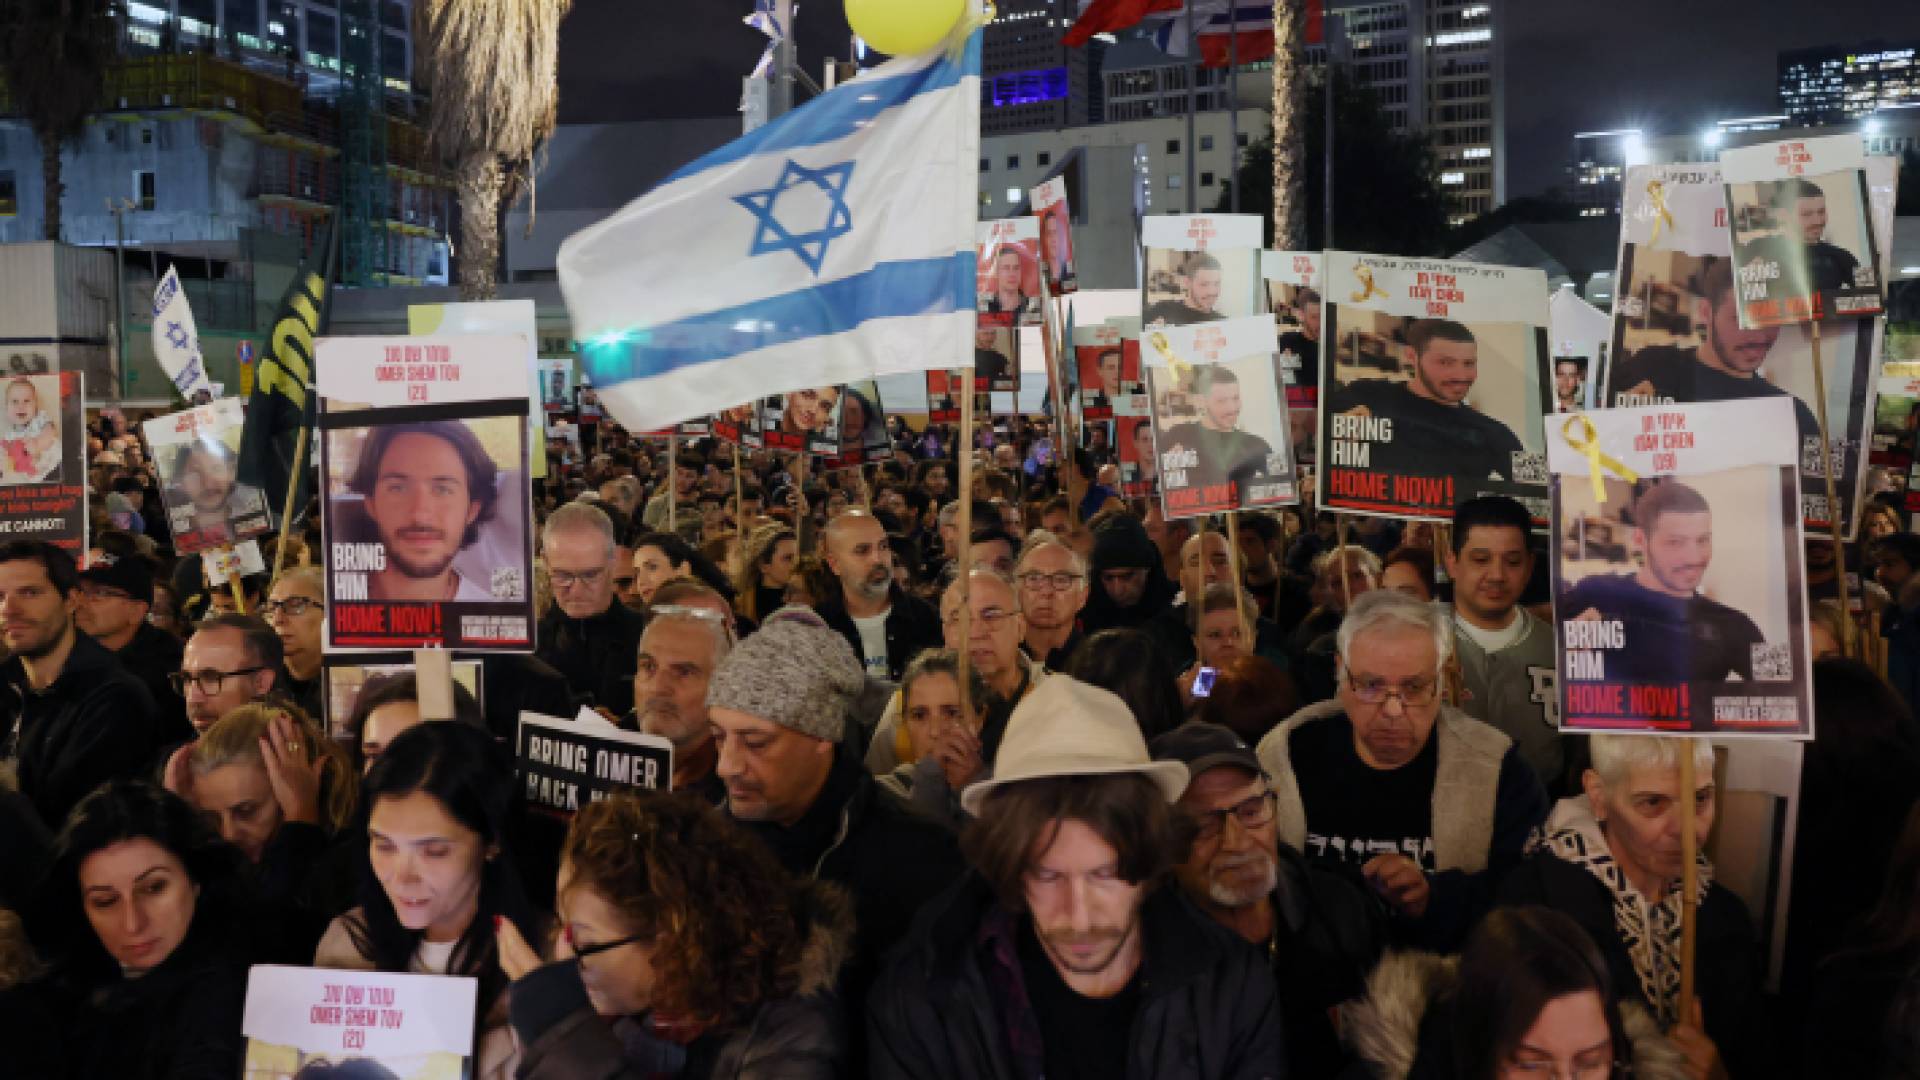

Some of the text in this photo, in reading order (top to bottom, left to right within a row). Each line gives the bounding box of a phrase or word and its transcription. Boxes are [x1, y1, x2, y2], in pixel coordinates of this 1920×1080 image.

[375, 364, 460, 382] OMER SHEM TOV
[1332, 415, 1392, 442] BRING
[1663, 432, 1694, 448] CHEN
[1332, 439, 1370, 468] HIM
[1330, 468, 1389, 500] HOME
[1393, 474, 1456, 505] NOW!
[332, 542, 386, 571] BRING
[334, 572, 368, 600] HIM
[335, 602, 441, 634] HOME NOW!
[1565, 620, 1625, 649] BRING
[1566, 650, 1605, 681] HIM
[1567, 684, 1624, 715] HOME
[1630, 682, 1689, 718] NOW!
[528, 735, 657, 789] BRING OMER
[526, 772, 579, 811] BACK
[345, 985, 364, 1005] שם
[367, 987, 395, 1007] עומר
[310, 1006, 403, 1029] OMER SHEM TOV
[342, 1029, 365, 1050] (21)
